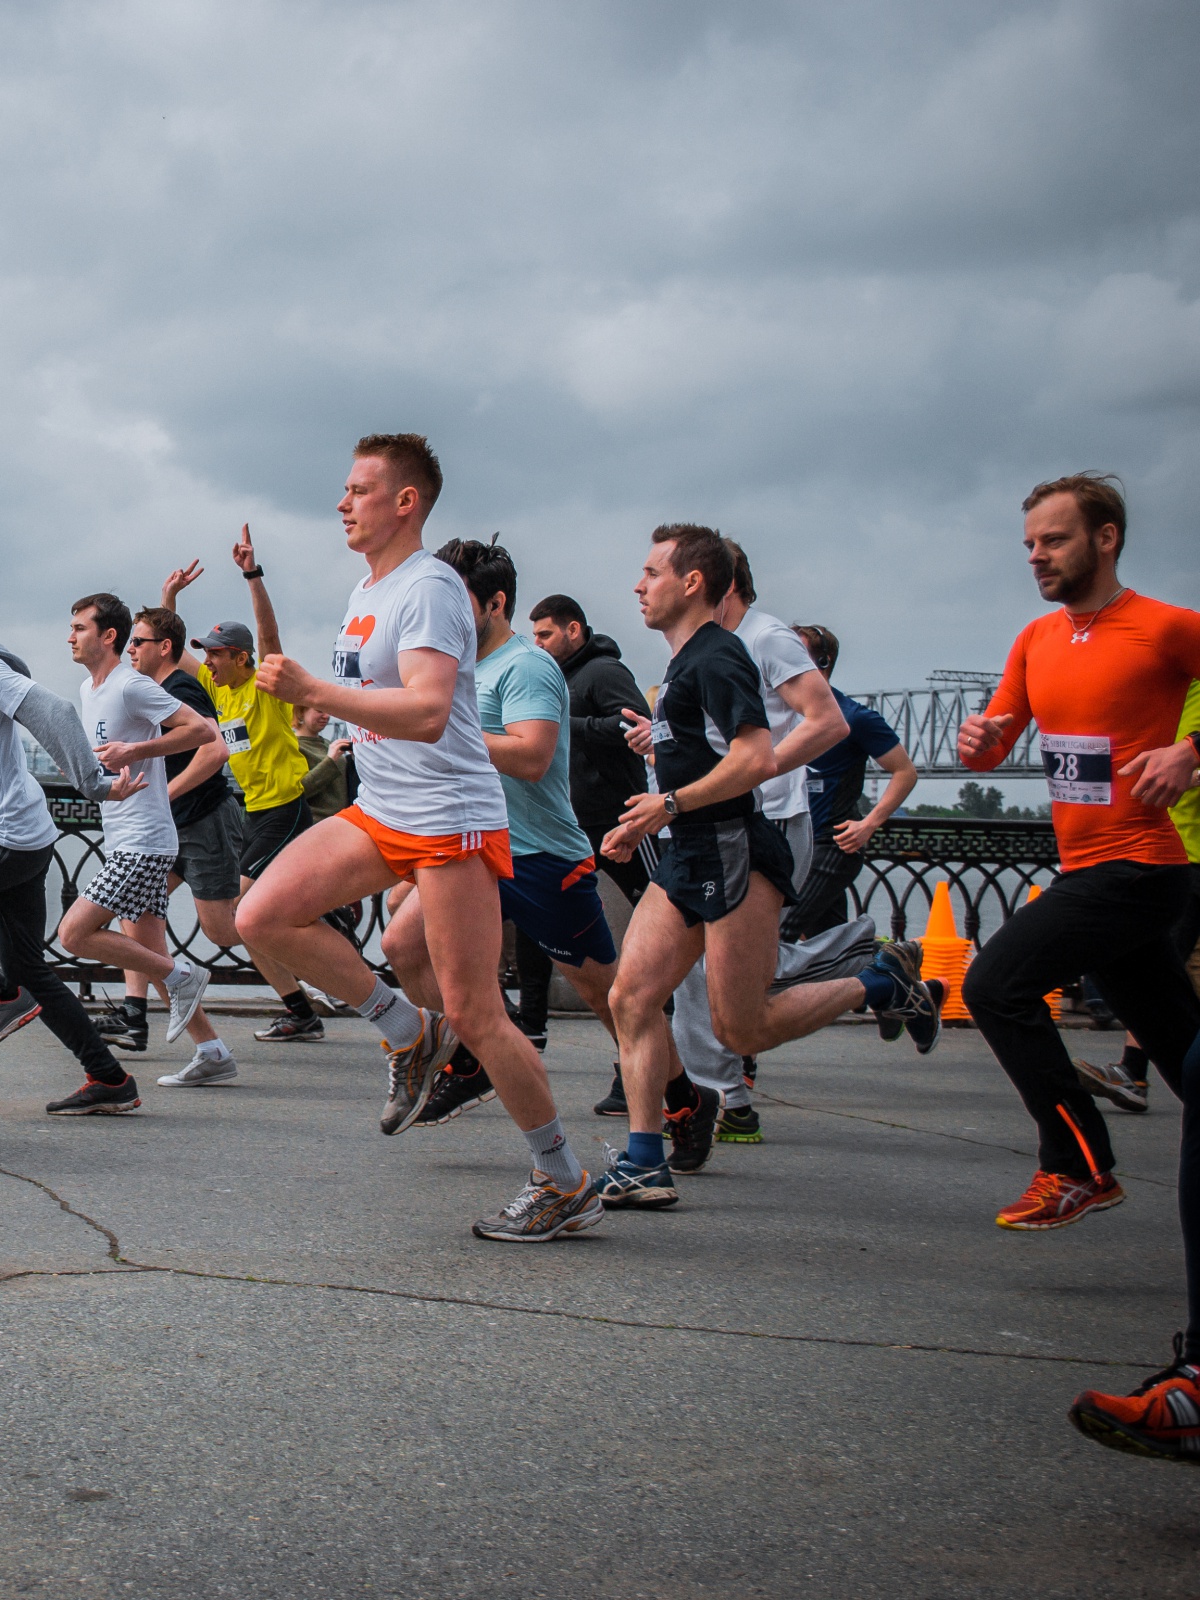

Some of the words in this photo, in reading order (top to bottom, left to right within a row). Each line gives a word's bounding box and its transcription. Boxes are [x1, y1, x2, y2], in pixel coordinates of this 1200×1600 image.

[334, 651, 347, 676] 87
[224, 729, 236, 744] 80
[1053, 753, 1079, 780] 28
